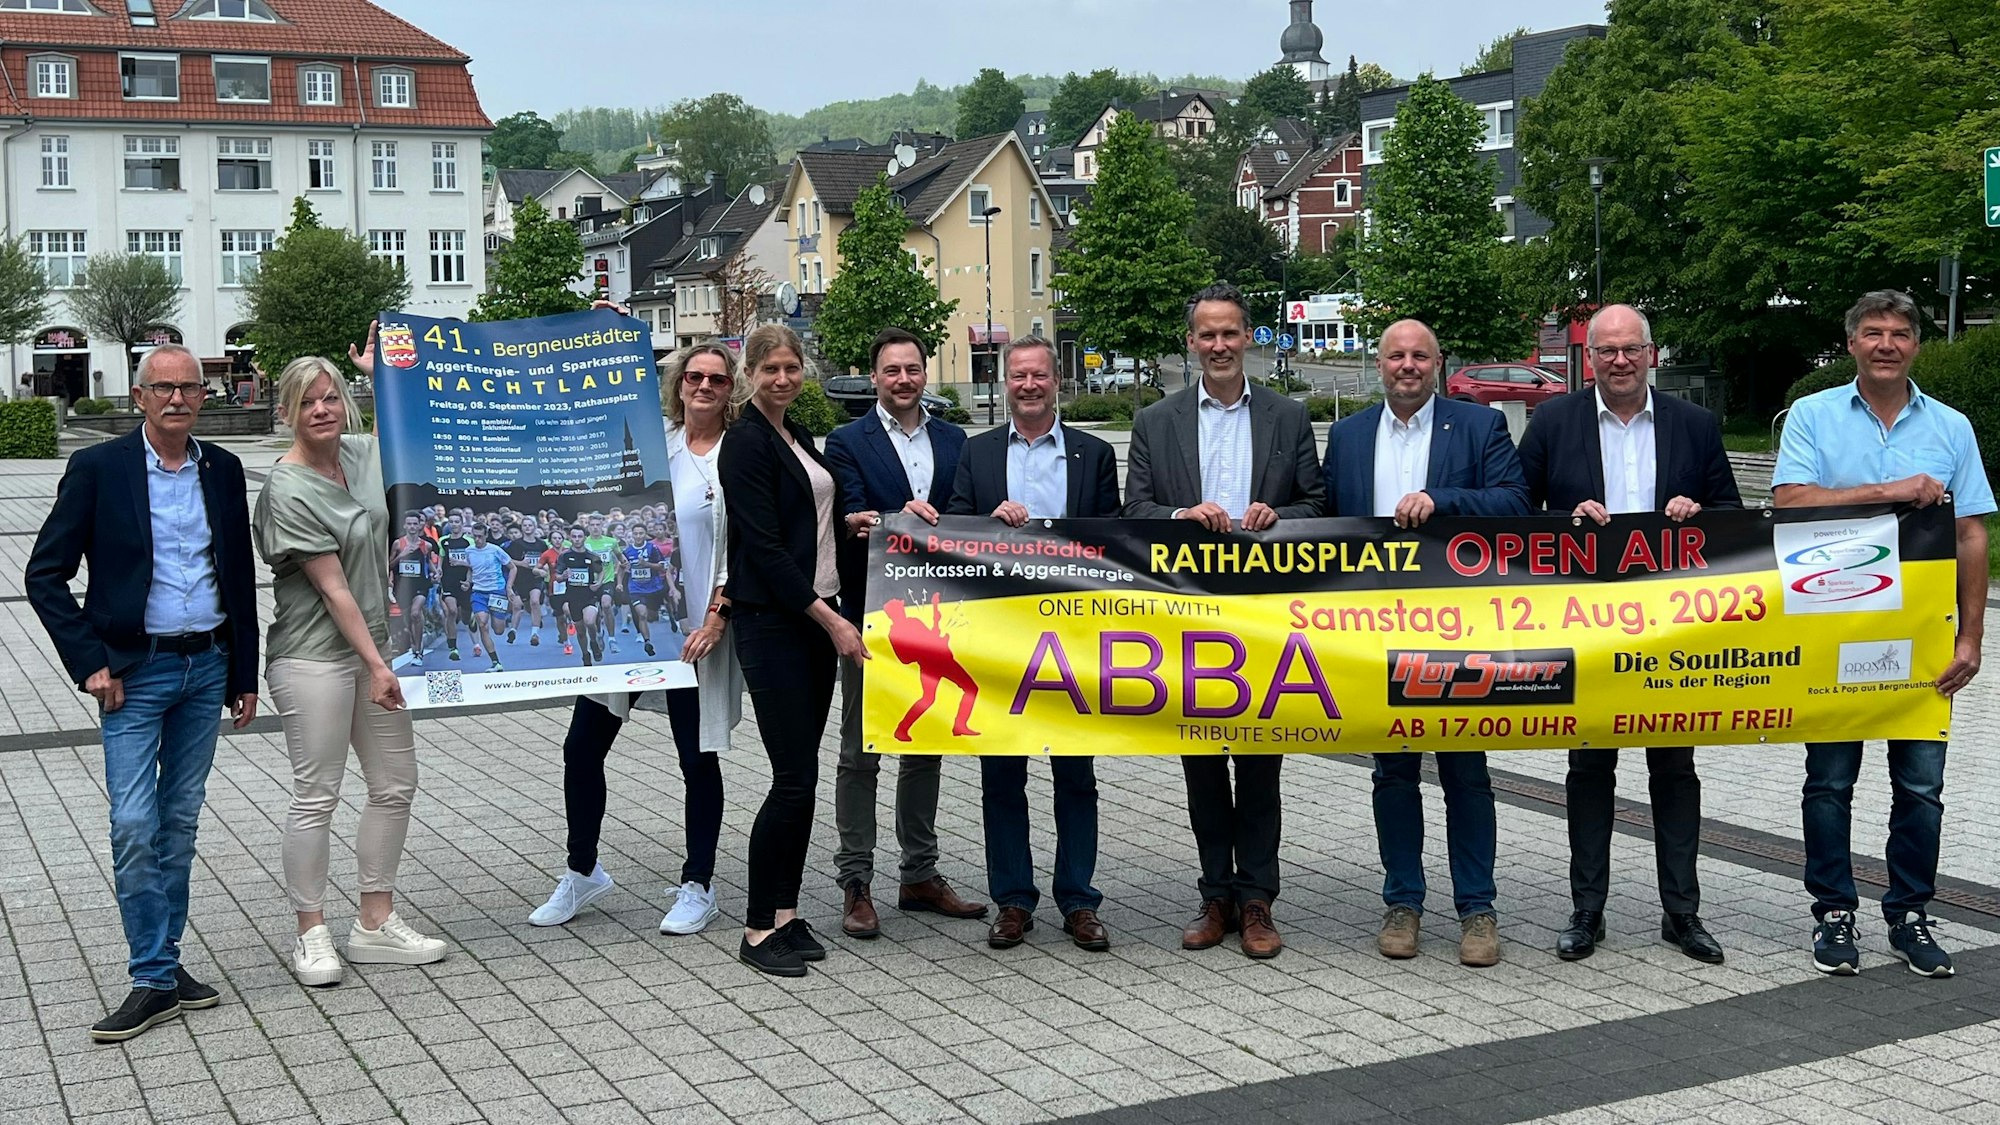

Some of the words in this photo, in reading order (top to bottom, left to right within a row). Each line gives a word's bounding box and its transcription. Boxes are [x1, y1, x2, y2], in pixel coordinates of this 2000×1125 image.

[424, 325, 480, 355] 41.
[493, 328, 641, 358] Bergneustädter
[426, 361, 520, 378] AggerEnergie-
[529, 364, 554, 375] und
[562, 354, 644, 372] Sparkassen-
[429, 400, 467, 410] Freitag,
[470, 401, 486, 409] 08.
[488, 402, 541, 411] September
[544, 403, 571, 411] 2023,
[574, 393, 638, 408] Rathausplatz
[550, 456, 577, 464] Jahrgang
[1814, 528, 1848, 538] powered
[886, 534, 918, 554] 20.
[927, 536, 1106, 560] Bergneustädter
[1150, 542, 1421, 574] RATHAUSPLATZ
[1446, 532, 1597, 577] OPEN
[1617, 526, 1709, 574] AIR
[884, 562, 987, 580] Sparkassen
[992, 563, 1004, 576] &
[1010, 562, 1134, 582] AggerEnergie
[1039, 598, 1084, 616] ONE
[1092, 599, 1158, 616] NIGHT
[1165, 600, 1220, 616] WITH
[1289, 598, 1474, 641] Samstag,
[1490, 596, 1546, 630] 12.
[1562, 596, 1657, 634] Aug.
[1670, 584, 1766, 623] 2023
[1614, 652, 1658, 673] Die
[1669, 646, 1800, 671] SoulBand
[485, 676, 598, 689] www.bergneustadt.de
[1009, 630, 1342, 720] ABBA
[1644, 676, 1673, 689] Aus
[1680, 676, 1708, 688] der
[1714, 673, 1770, 688] Region
[1842, 685, 1858, 694] Pop
[1861, 684, 1876, 692] aus
[1387, 718, 1425, 737] AB
[1438, 717, 1512, 737] 17.00
[1522, 716, 1577, 736] UHR
[1613, 711, 1722, 734] EINTRITT
[1732, 708, 1793, 730] FREI!
[1176, 724, 1264, 742] TRIBUTE
[1272, 727, 1342, 742] SHOW
